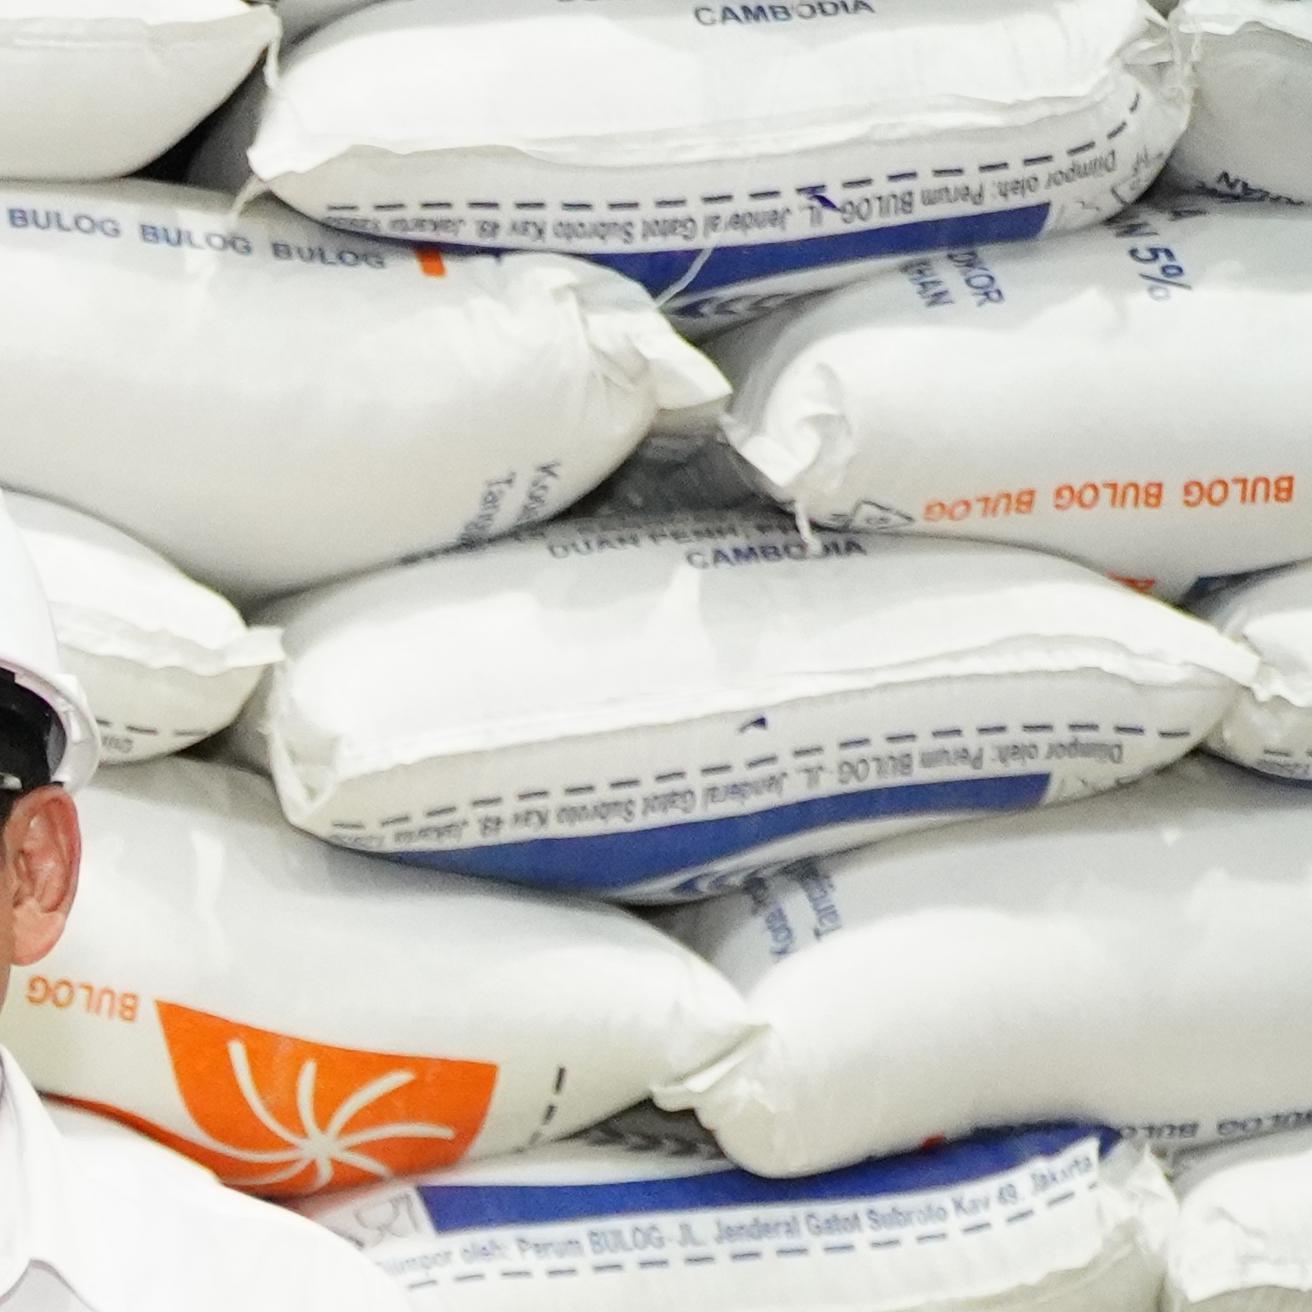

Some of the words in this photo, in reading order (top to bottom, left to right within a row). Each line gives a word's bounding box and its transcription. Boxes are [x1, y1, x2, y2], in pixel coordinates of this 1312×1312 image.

[8, 208, 122, 238] BULOG
[140, 223, 252, 255] BULOG
[271, 241, 385, 268] BULOG
[1128, 245, 1192, 301] 5%
[923, 487, 1037, 522] BULOG
[1052, 480, 1164, 512] BULOG
[1181, 475, 1295, 508] BULOG
[25, 975, 140, 1024] BULOG
[587, 1224, 666, 1255] BULOG
